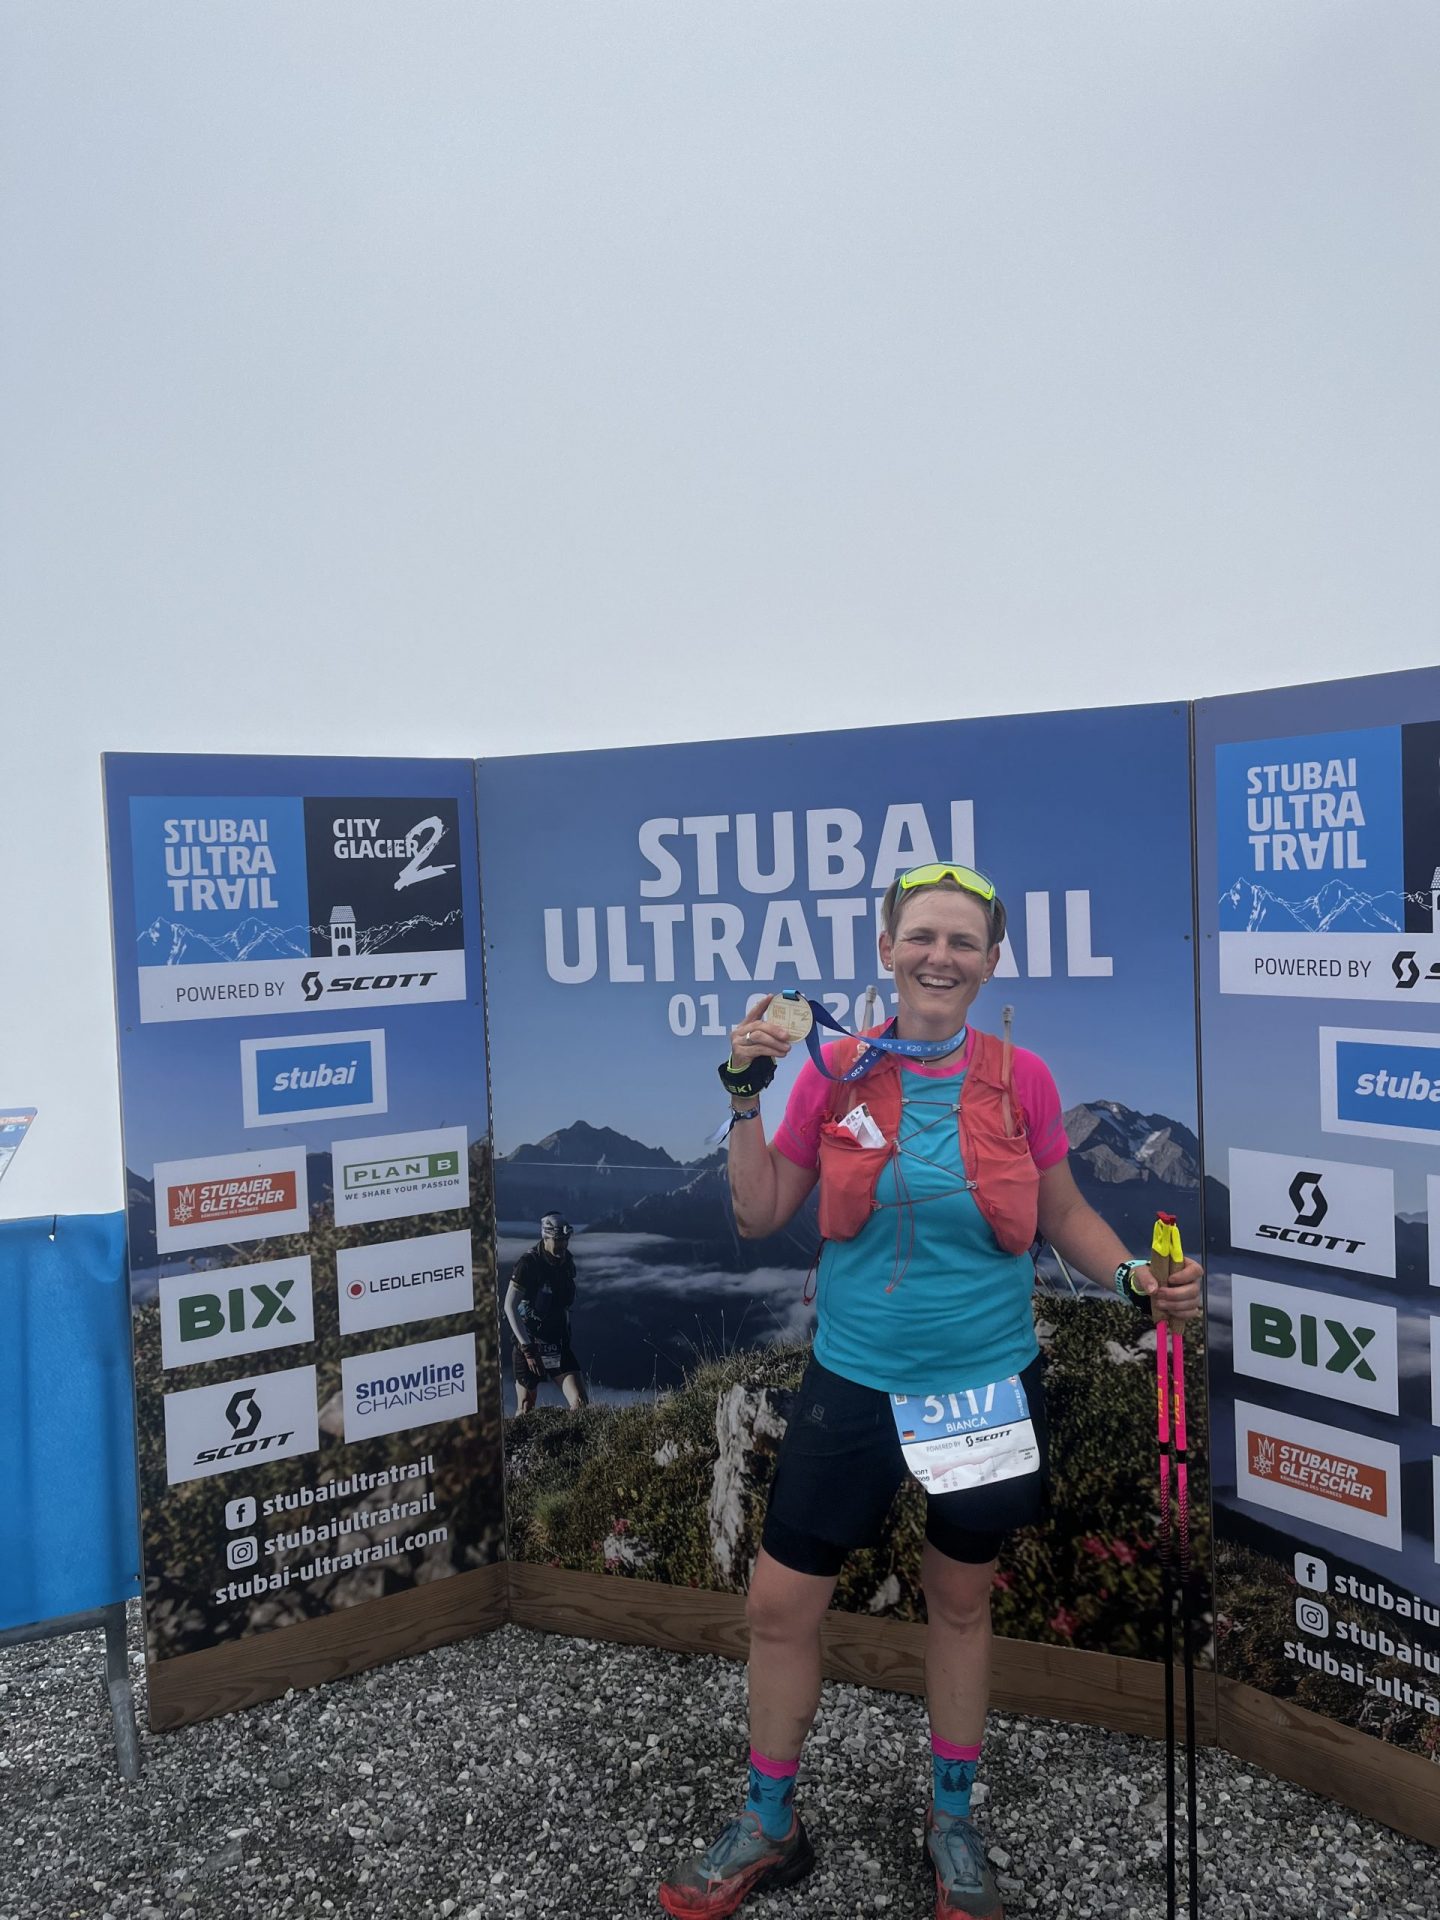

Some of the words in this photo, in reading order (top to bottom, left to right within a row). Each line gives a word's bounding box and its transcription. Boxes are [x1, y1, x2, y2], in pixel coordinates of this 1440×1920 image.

[1247, 757, 1357, 795] STUBAI
[332, 818, 381, 838] CITY
[1247, 790, 1366, 832] ULTRA
[164, 819, 268, 844] STUBAI
[334, 838, 419, 859] GLACIER
[638, 799, 976, 898] STUBAI
[164, 846, 276, 876] ULTRA
[1248, 830, 1367, 871] TRAIL
[167, 878, 278, 912] TRAIL
[543, 890, 1113, 984] ULTRATIL
[1254, 958, 1342, 978] POWERED
[1348, 960, 1371, 978] BY
[176, 982, 260, 1003] POWERED
[264, 981, 285, 998] BY
[327, 972, 437, 994] SCOTT
[906, 1044, 922, 1052] K20
[273, 1059, 357, 1093] stubai
[354, 1163, 421, 1182] PLAN
[437, 1159, 452, 1171] B
[200, 1178, 272, 1200] STUBAIER
[200, 1189, 285, 1213] GLETSCHER
[362, 1188, 391, 1199] SHARE
[394, 1184, 418, 1194] YOUR
[421, 1179, 460, 1190] PASSION
[1255, 1224, 1366, 1254] SCOTT
[370, 1265, 465, 1293] LEDLENSER
[178, 1279, 296, 1342] BIX
[1249, 1302, 1377, 1382] BIX
[356, 1363, 465, 1400] snowline
[356, 1380, 465, 1415] CHAINSEN
[922, 1382, 996, 1424] 3117
[926, 1441, 953, 1452] POWERED
[954, 1440, 961, 1448] BY
[974, 1429, 1013, 1443] SCOTT
[945, 1416, 989, 1433] BIANCA
[193, 1431, 295, 1466] SCOTT
[1279, 1445, 1358, 1481] STUBAIER
[263, 1455, 435, 1516] stubaiultratrail
[1279, 1461, 1373, 1501] GLETSCHER
[264, 1492, 436, 1556] stubaiultratrail
[215, 1526, 448, 1605] stubai-ultratrail.com
